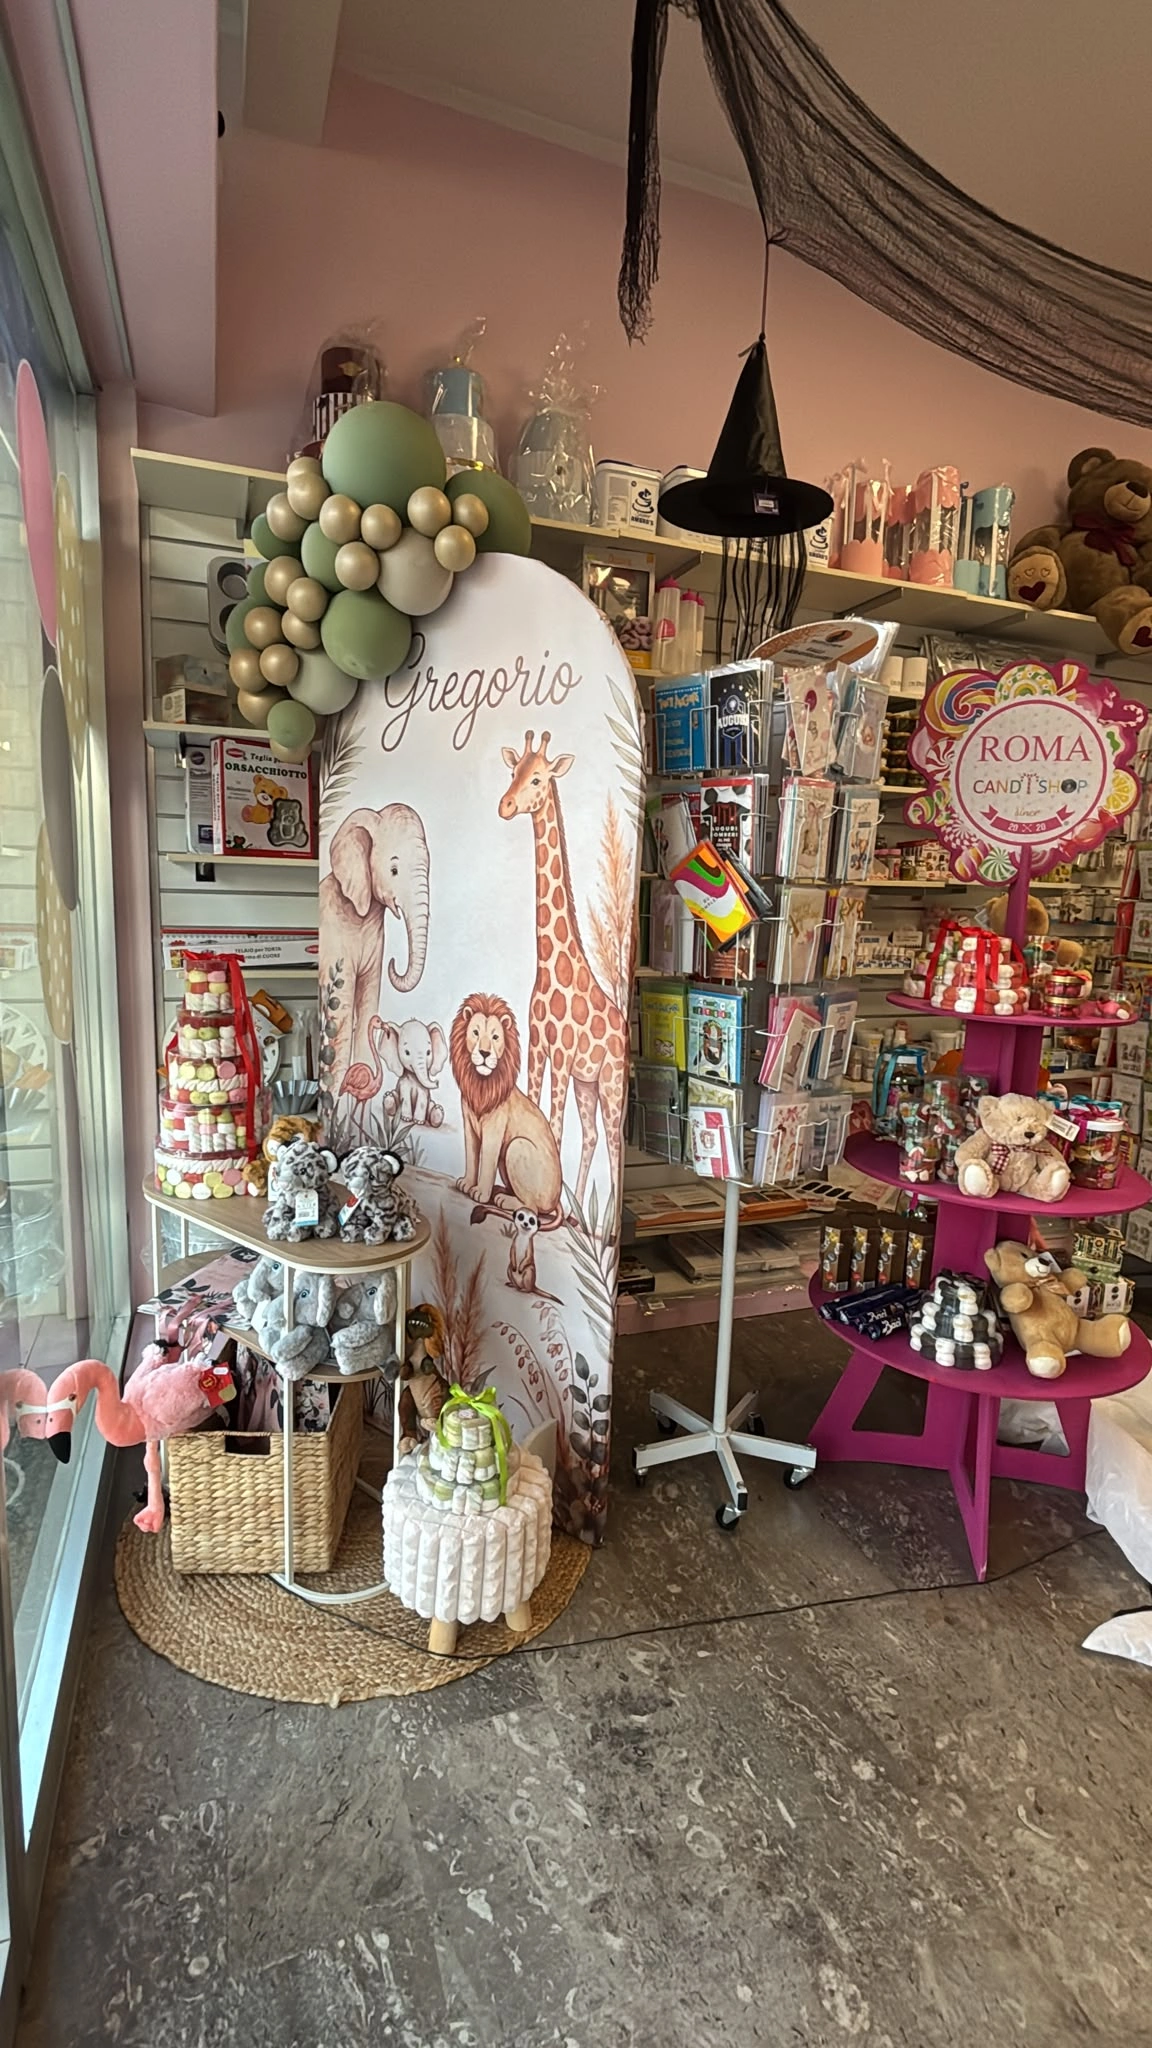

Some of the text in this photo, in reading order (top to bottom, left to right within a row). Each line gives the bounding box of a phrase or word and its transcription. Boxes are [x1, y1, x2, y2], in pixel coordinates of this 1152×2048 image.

[381, 632, 583, 752] Gregorio
[250, 752, 272, 763] Teglia
[978, 735, 1092, 762] ROMA
[225, 762, 308, 780] ORSACCHIOTTO
[1008, 822, 1046, 832] 20 20
